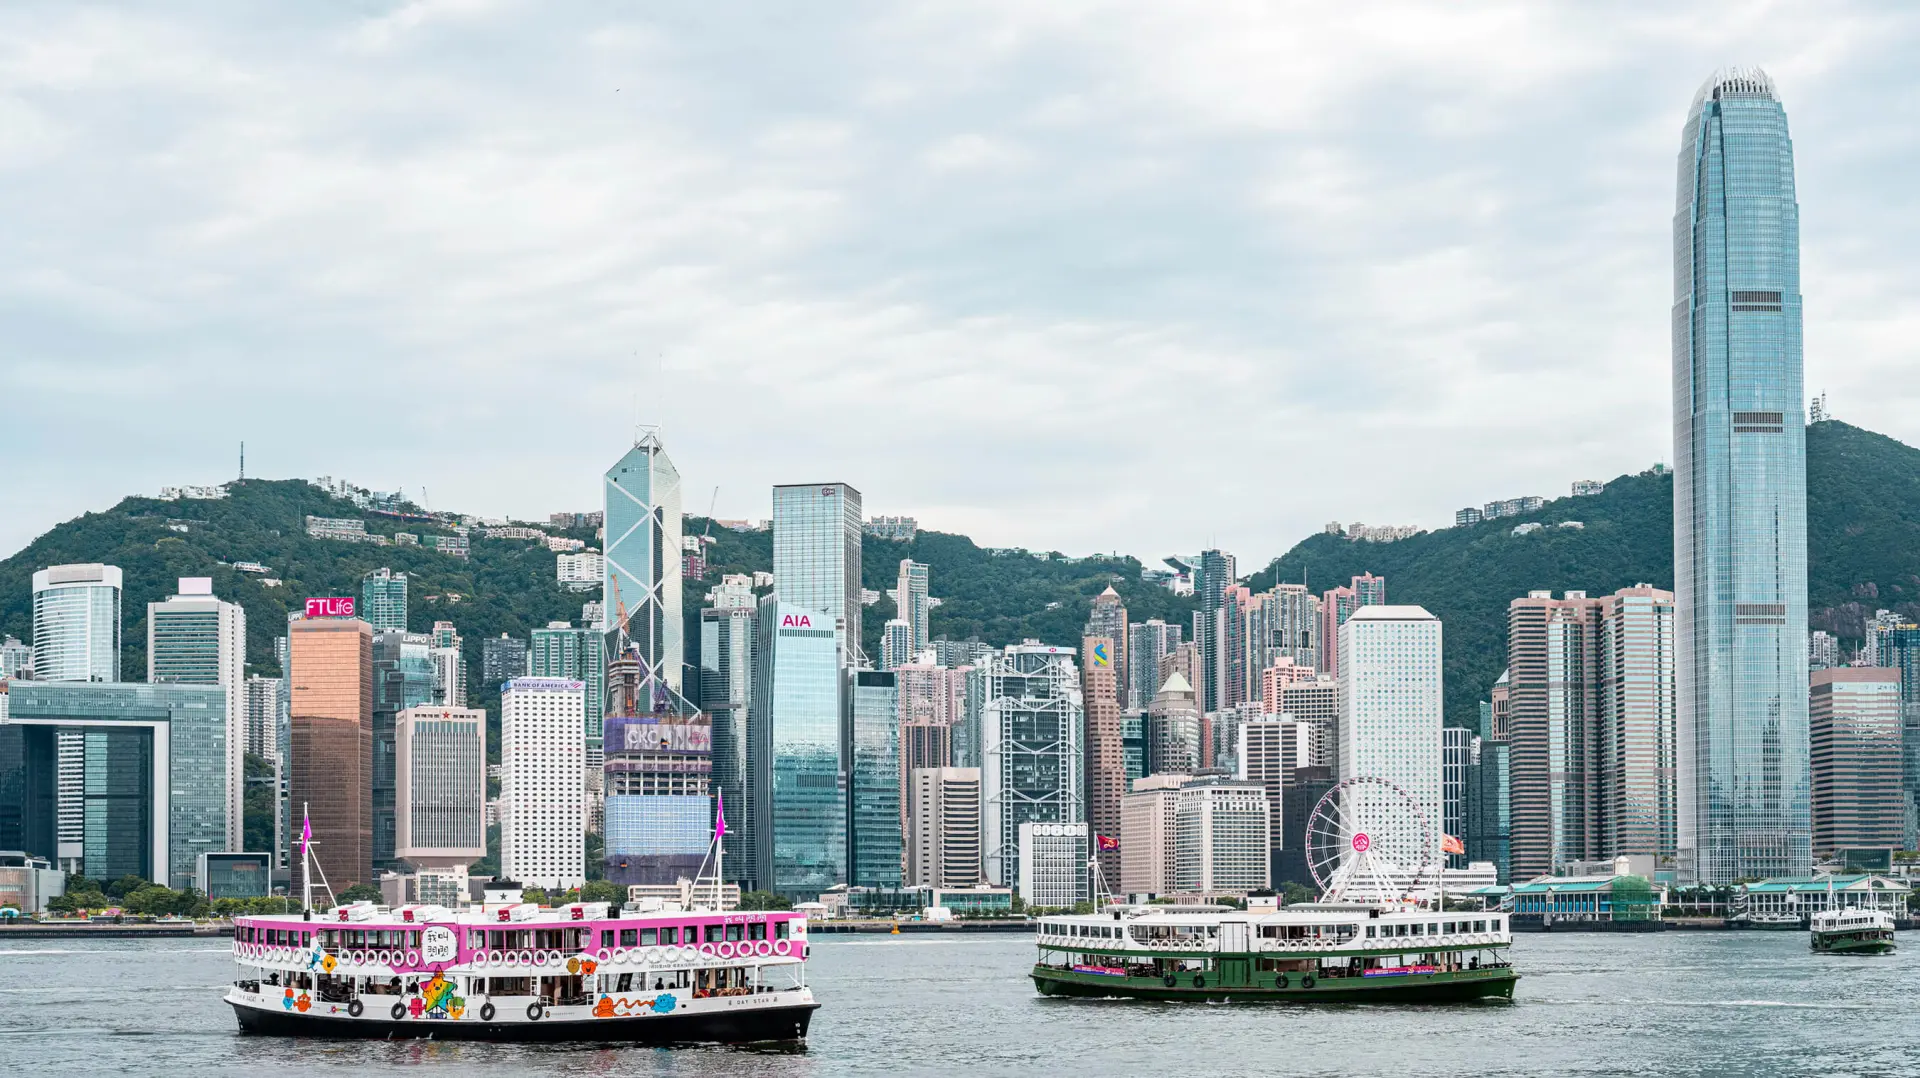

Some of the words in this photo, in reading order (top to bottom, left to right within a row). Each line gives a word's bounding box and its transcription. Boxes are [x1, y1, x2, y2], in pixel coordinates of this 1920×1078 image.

[305, 599, 354, 615] FTLife
[731, 610, 749, 619] citi
[782, 614, 811, 628] AIA
[402, 634, 427, 644] LIPPO
